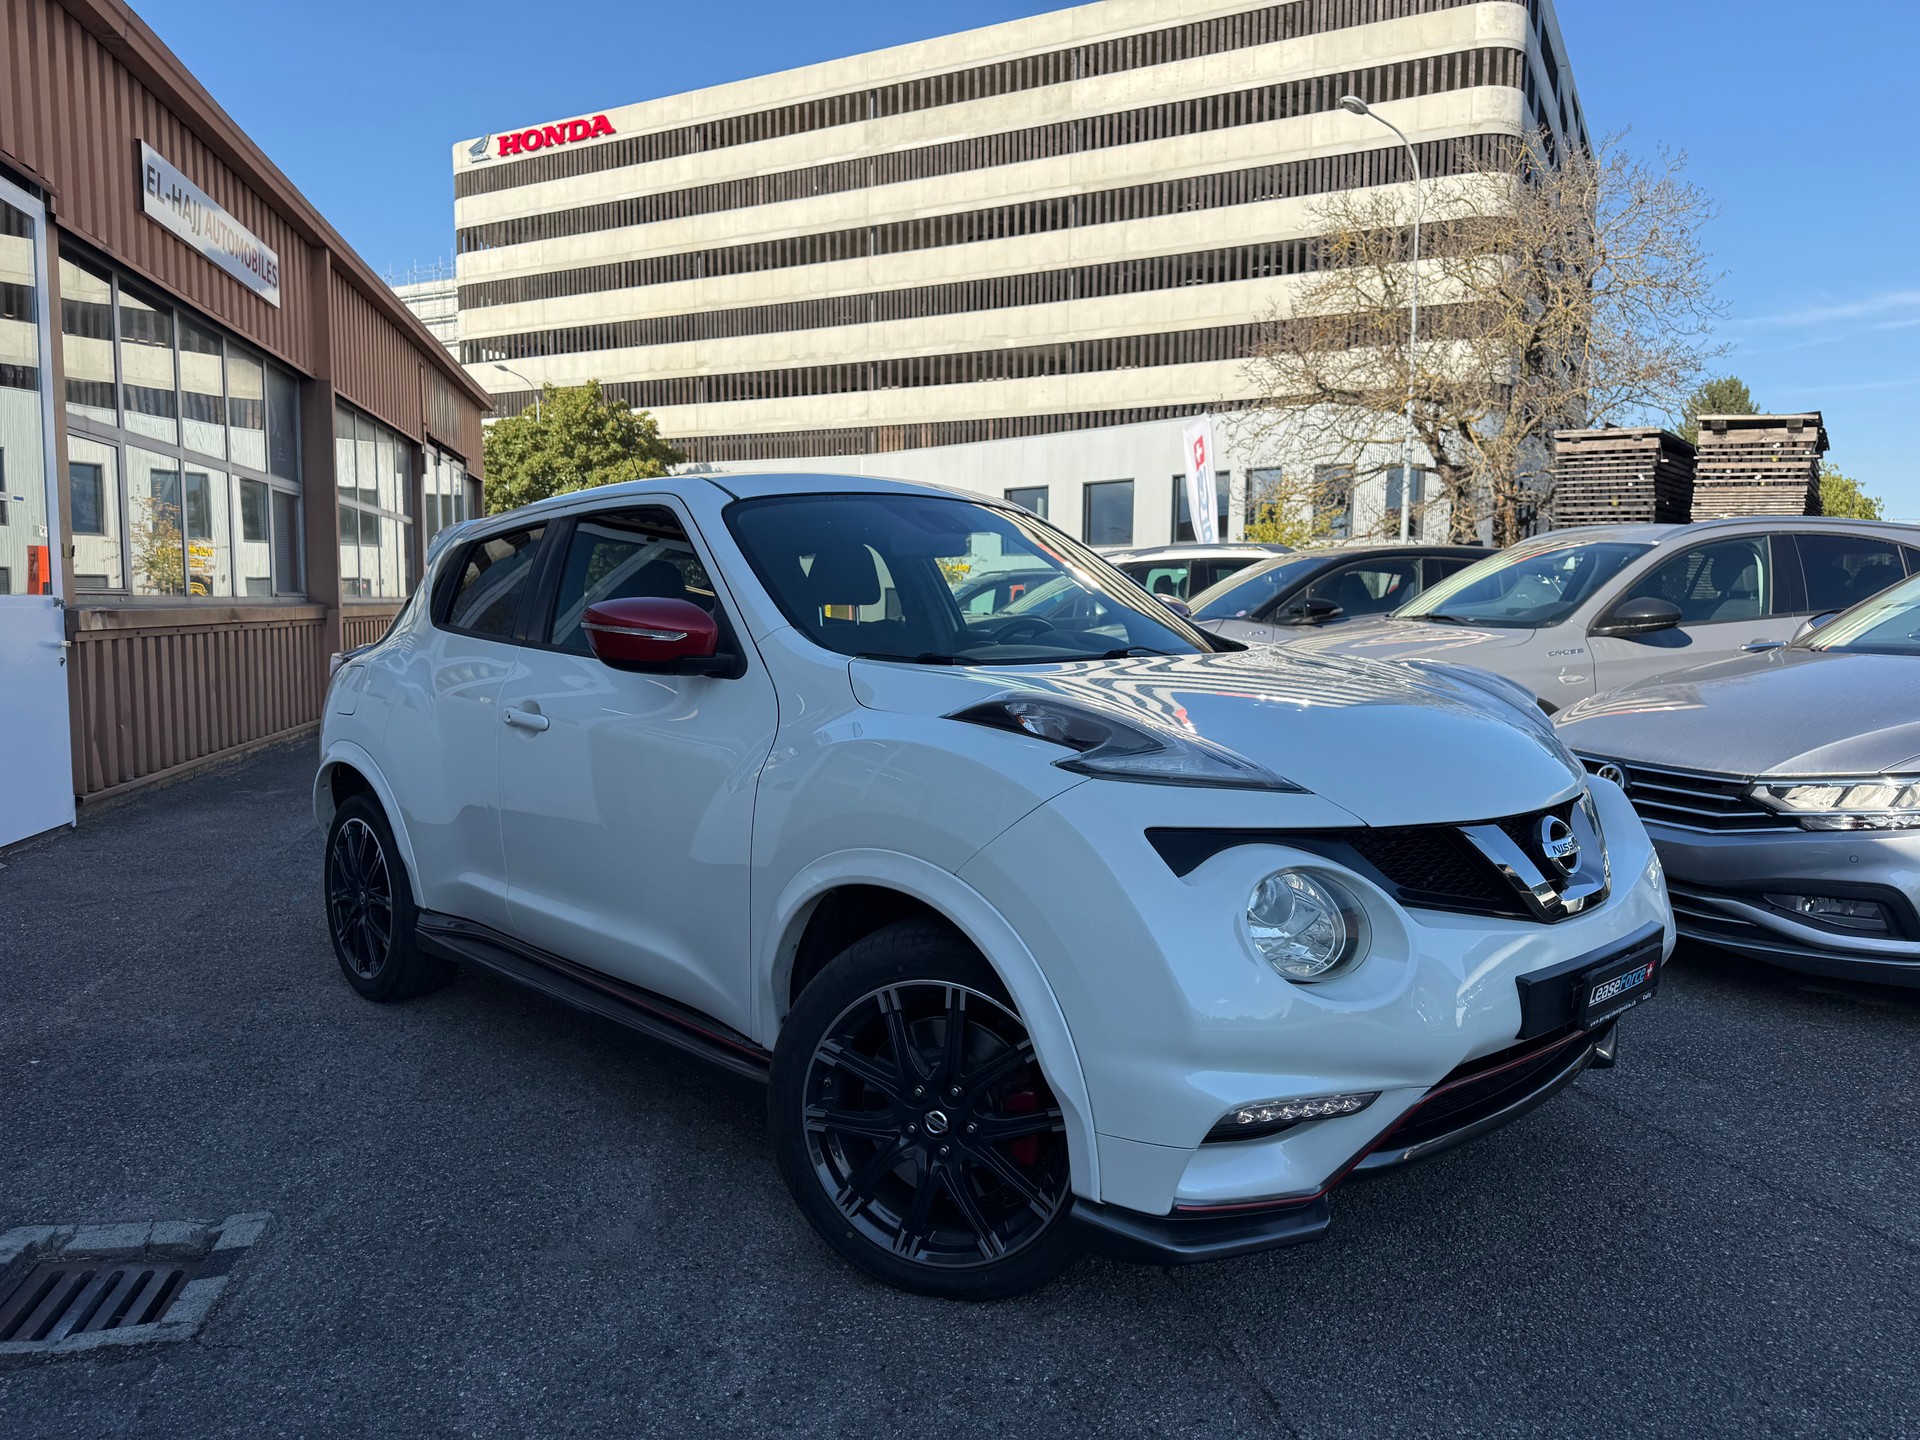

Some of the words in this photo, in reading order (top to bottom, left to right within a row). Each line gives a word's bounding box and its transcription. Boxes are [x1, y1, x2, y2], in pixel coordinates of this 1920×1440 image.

[497, 115, 616, 157] HONDA
[146, 163, 202, 237] EL-HAJJ
[204, 210, 278, 288] AUTOMOBILES
[1589, 966, 1646, 1005] LeaseForce
